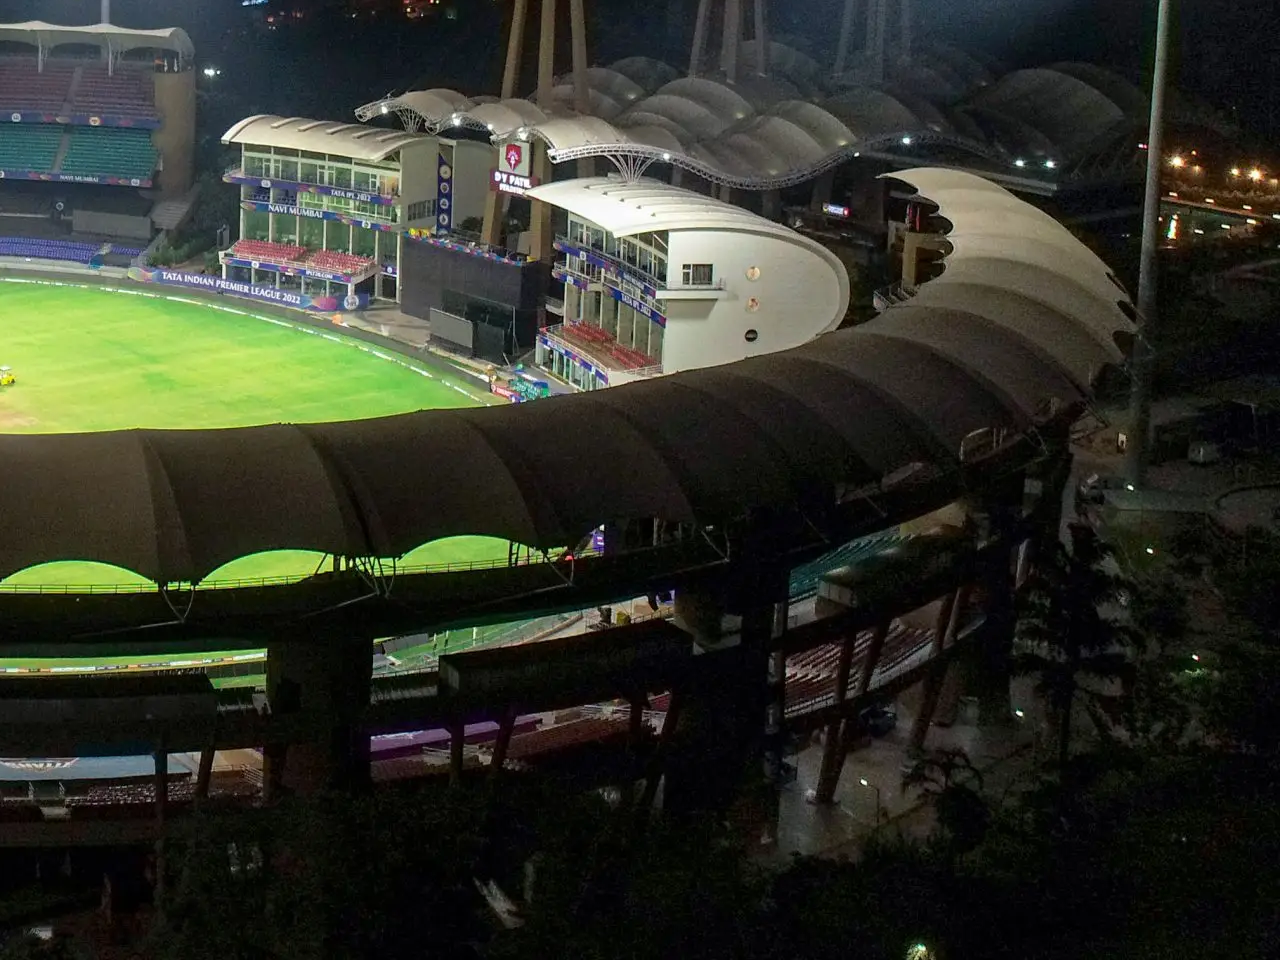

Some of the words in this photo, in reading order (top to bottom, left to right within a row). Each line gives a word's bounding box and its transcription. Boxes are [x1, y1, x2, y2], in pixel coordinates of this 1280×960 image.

[331, 189, 345, 198] TATA
[356, 193, 371, 201] 2022
[268, 204, 288, 214] NAVI
[289, 206, 323, 218] MUMBAI
[161, 271, 182, 281] TATA
[184, 274, 215, 286] INDIAN
[215, 280, 250, 293] PREMIER
[250, 287, 281, 300] LEAGUE
[282, 293, 301, 304] 2022
